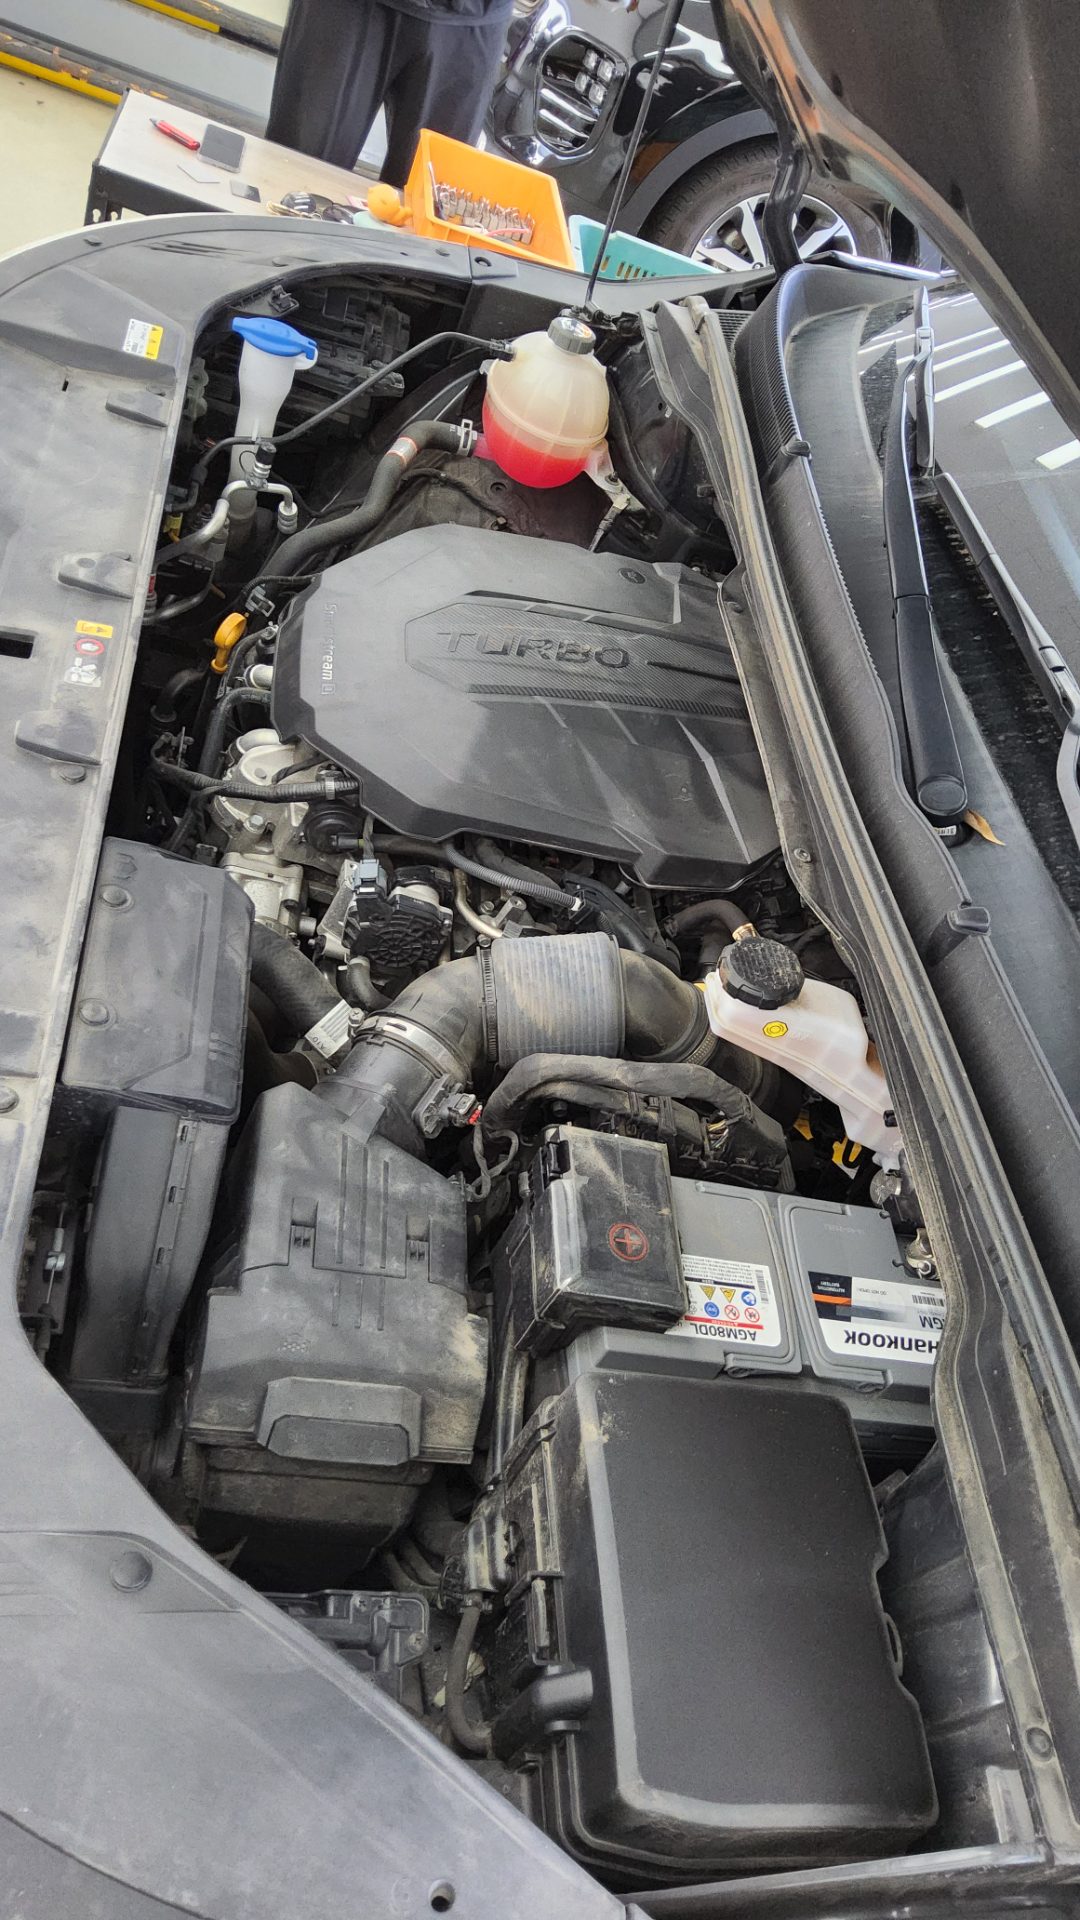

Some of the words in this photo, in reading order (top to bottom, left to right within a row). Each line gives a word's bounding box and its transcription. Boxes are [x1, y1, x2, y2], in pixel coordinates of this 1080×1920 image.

[437, 632, 630, 668] TURBO
[690, 1322, 757, 1341] AGM80DL
[920, 1315, 945, 1329] GM
